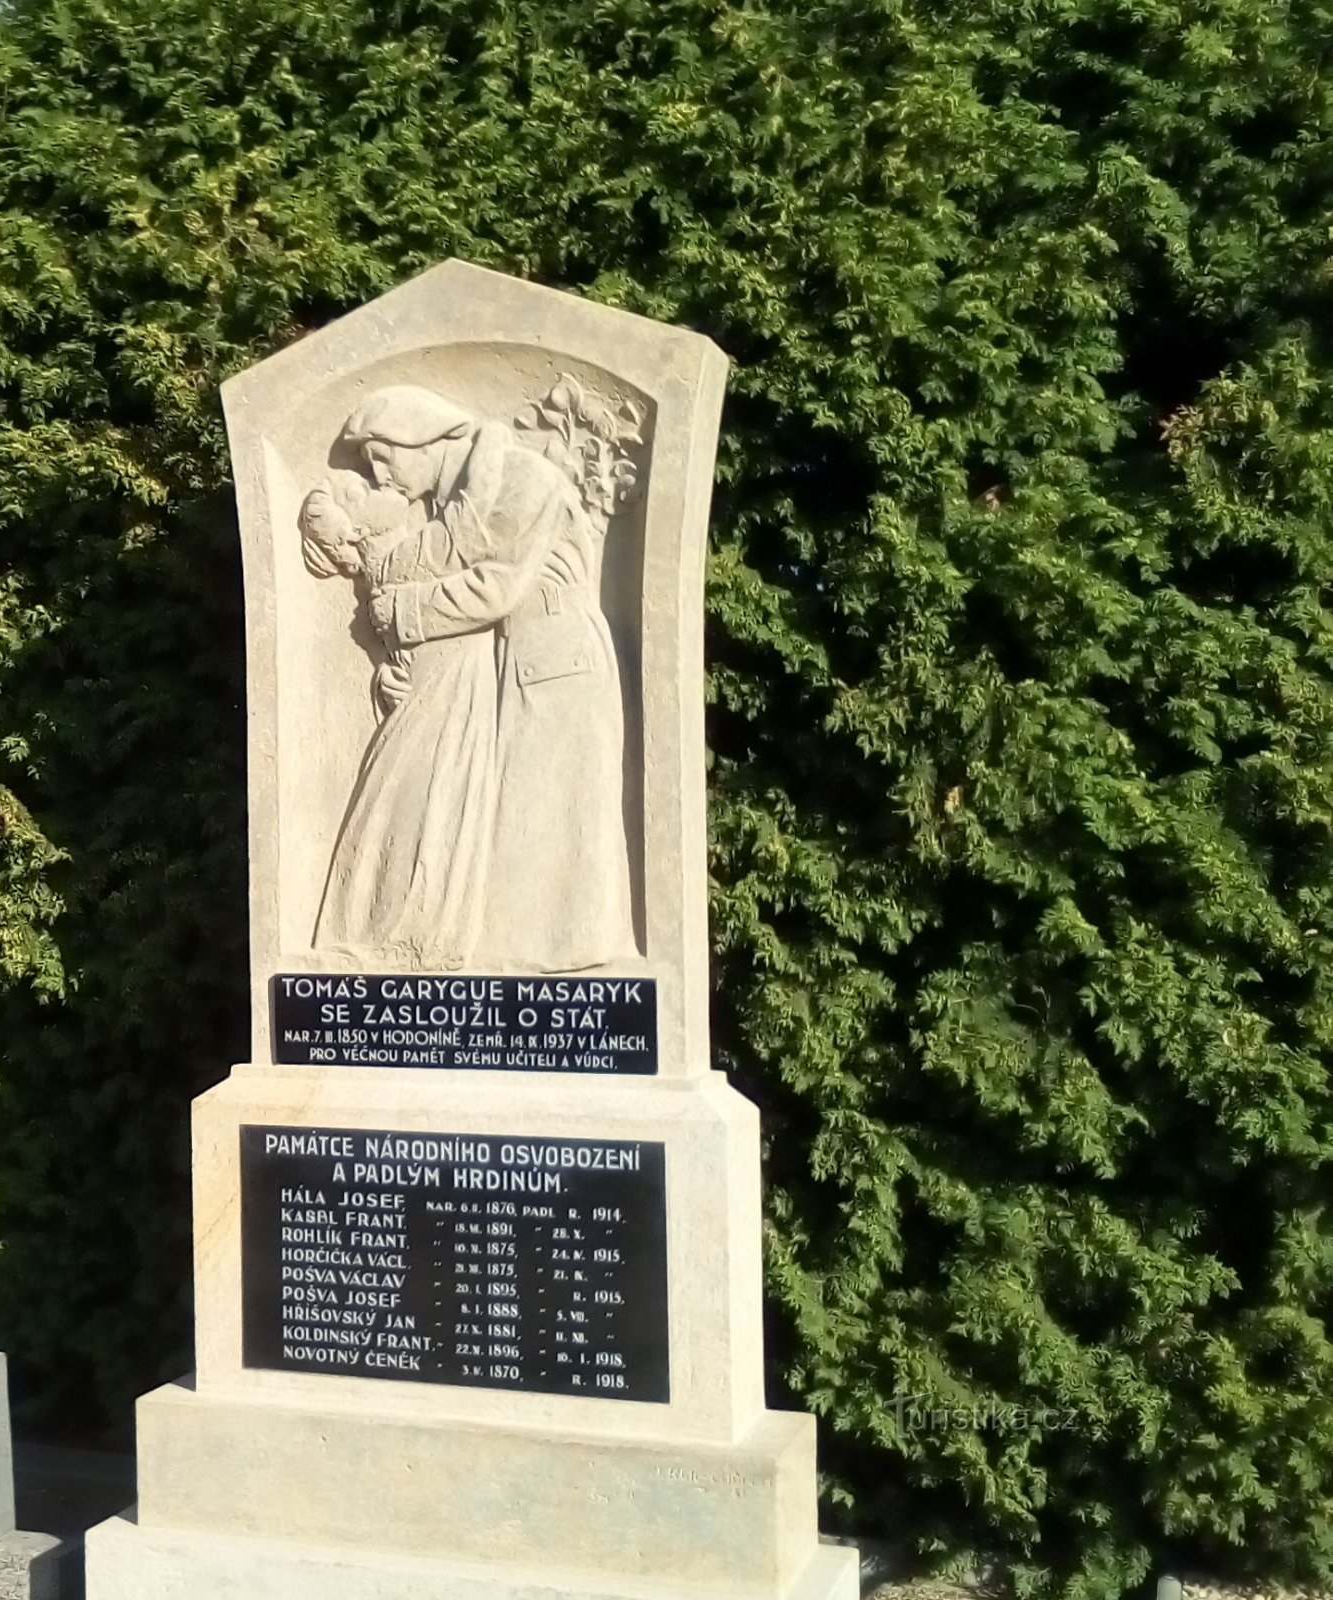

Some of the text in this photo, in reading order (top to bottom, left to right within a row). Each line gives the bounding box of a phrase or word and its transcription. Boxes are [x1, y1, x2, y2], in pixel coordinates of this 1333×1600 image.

[281, 976, 642, 1004] TOMÁŠ GARYGUE MASARYK
[321, 1003, 351, 1024] SE
[363, 1002, 507, 1027] ZASLOUŽIL
[518, 1007, 538, 1028] O
[590, 1031, 650, 1052] LÁNECH.
[309, 1047, 337, 1061] PRO
[342, 1045, 398, 1062] VĚČNOU
[454, 1048, 501, 1066] SVÉMU
[506, 1049, 556, 1067] UČITELI
[561, 1055, 569, 1068] A
[265, 1130, 641, 1171] PAMÁTCE NÁRODNÍHO OSVOBOZENÍ
[332, 1162, 569, 1194] A PADLÝM HRDINŮM.
[281, 1185, 326, 1205] HÁLA
[282, 1225, 342, 1245] ROHLÍK
[281, 1247, 364, 1266] HORČIČKA
[282, 1265, 337, 1284] POŠVA
[339, 1270, 406, 1288] VÁCLAV
[282, 1284, 338, 1304] POŠVA
[344, 1291, 401, 1308] JOSEF
[385, 1314, 416, 1330] JAN
[282, 1325, 371, 1347] KOLDINSKÝ
[283, 1345, 360, 1365] NOVOTNÝ
[366, 1351, 421, 1370] ČENĚK
